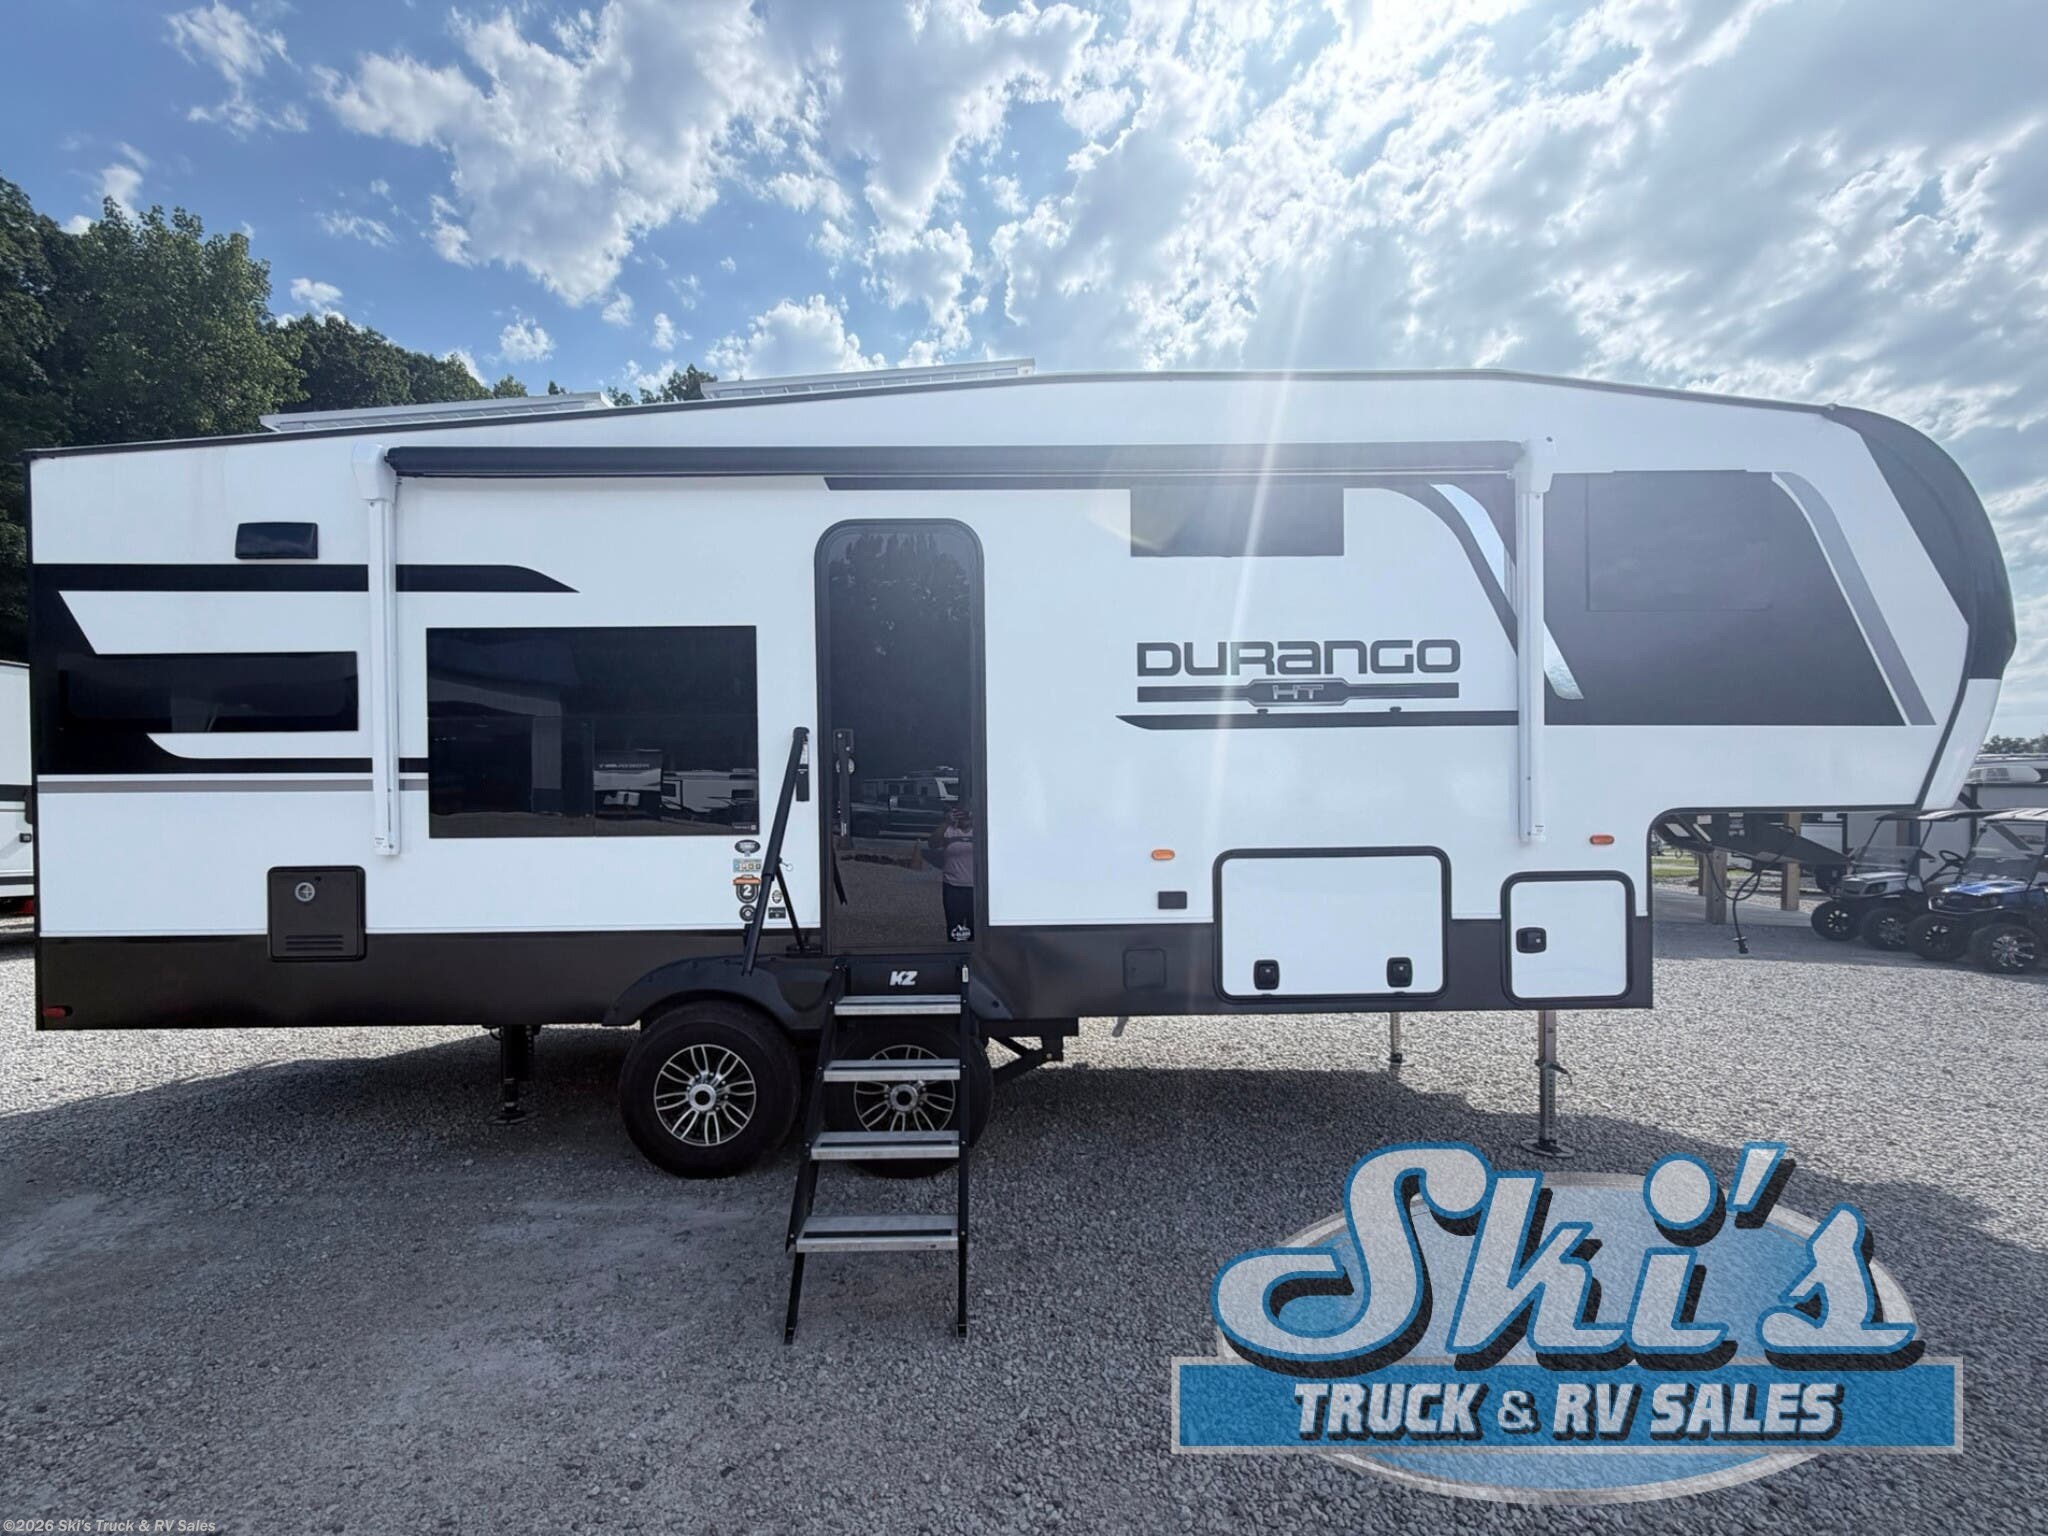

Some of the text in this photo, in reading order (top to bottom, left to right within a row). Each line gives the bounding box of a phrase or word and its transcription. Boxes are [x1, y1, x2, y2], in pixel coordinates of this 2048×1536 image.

[1273, 684, 1324, 700] HT
[743, 885, 752, 896] 2
[889, 970, 918, 986] KZ
